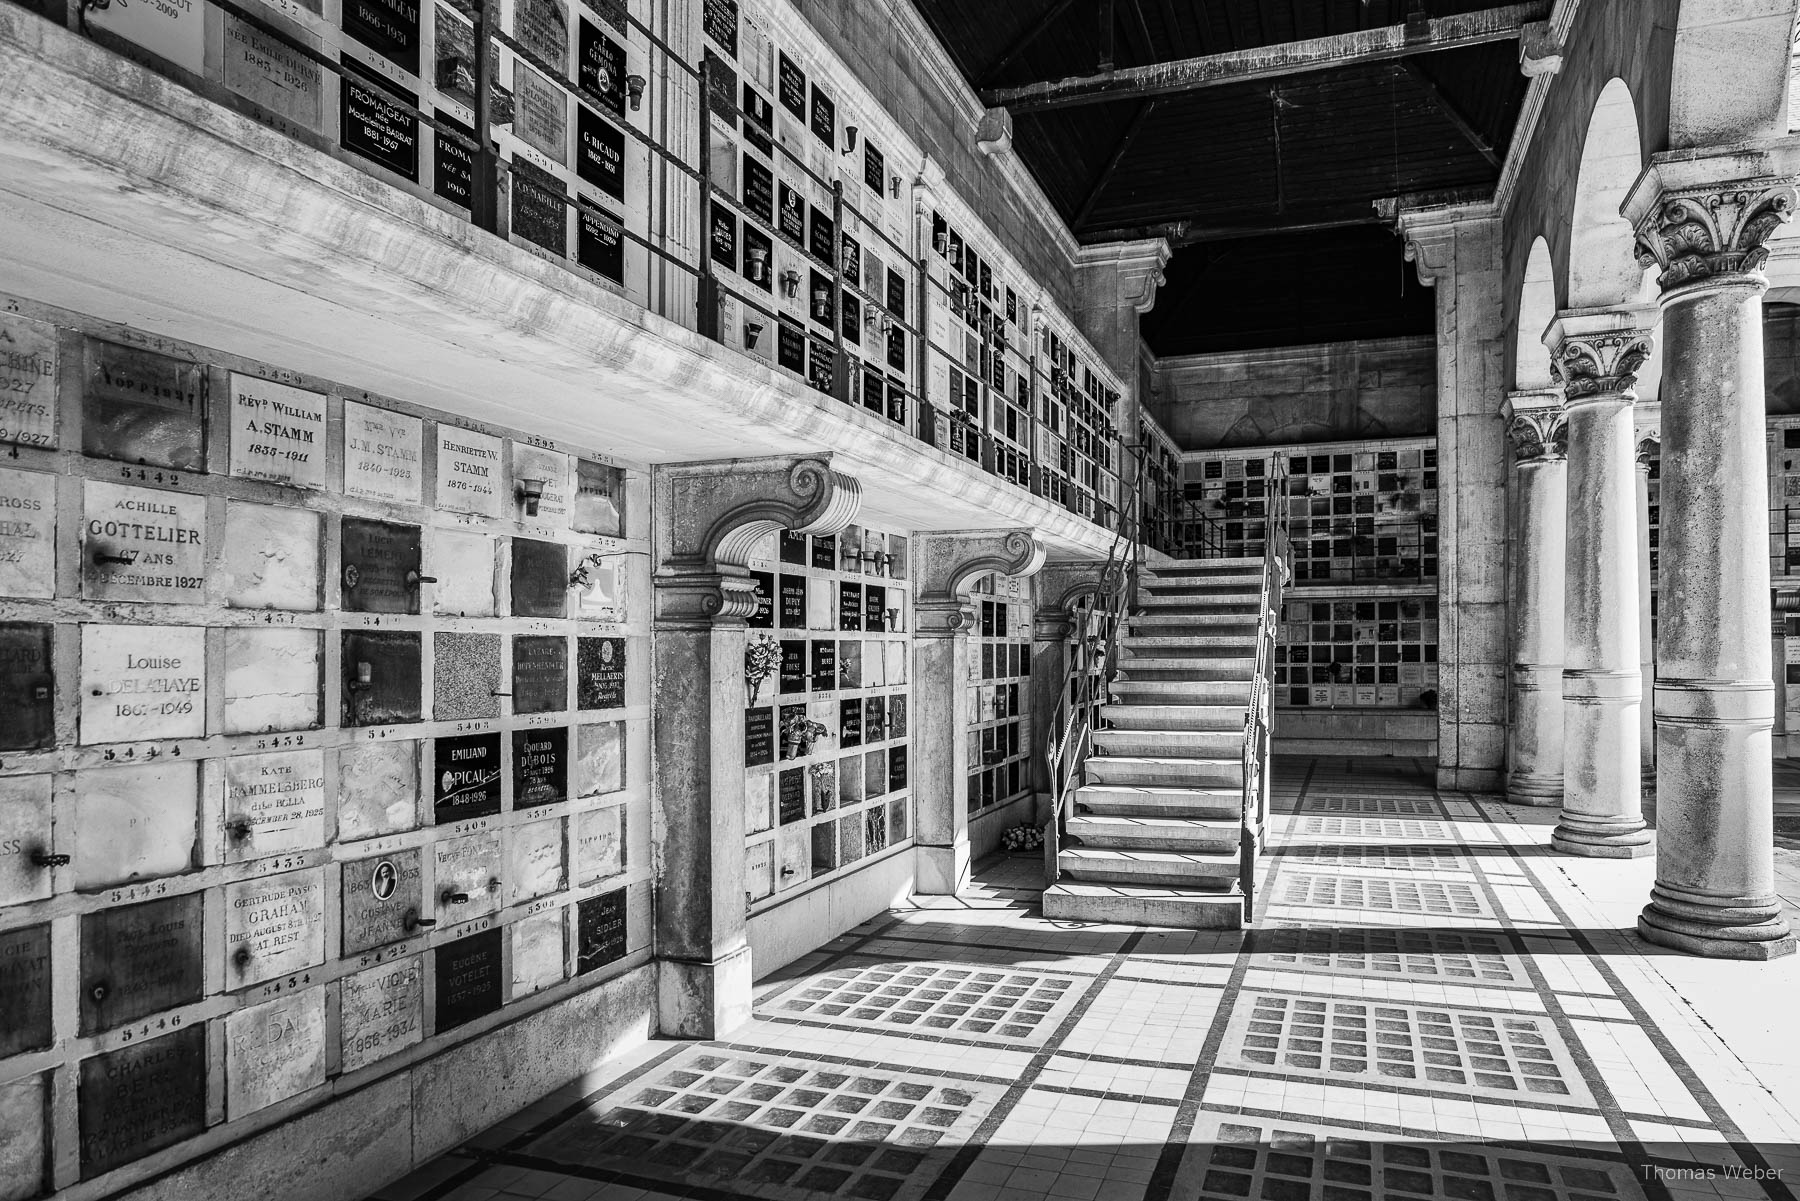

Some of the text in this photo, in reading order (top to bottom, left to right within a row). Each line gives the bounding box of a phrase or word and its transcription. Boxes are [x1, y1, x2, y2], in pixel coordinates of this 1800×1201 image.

[438, 139, 472, 164] FROMA
[271, 401, 323, 423] WILLIAM
[121, 466, 179, 486] 5442
[453, 460, 489, 478] STAMM
[115, 499, 178, 516] ACHILLE
[89, 519, 202, 546] GOTTELIER
[143, 553, 174, 565] ANS
[174, 576, 204, 589] 1927
[127, 654, 182, 670] Louise
[109, 678, 201, 694] DELAHAYE
[257, 734, 305, 750] 5432
[451, 746, 487, 761] EMILIAND
[521, 752, 556, 767] DUBOIS
[261, 766, 292, 776] KATE
[455, 821, 487, 833] 5409
[234, 891, 286, 909] GERTRUDE
[249, 899, 309, 924] GRAHAM
[596, 918, 623, 935] SIDLER
[229, 932, 251, 944] DIED
[121, 1014, 181, 1042] 5446
